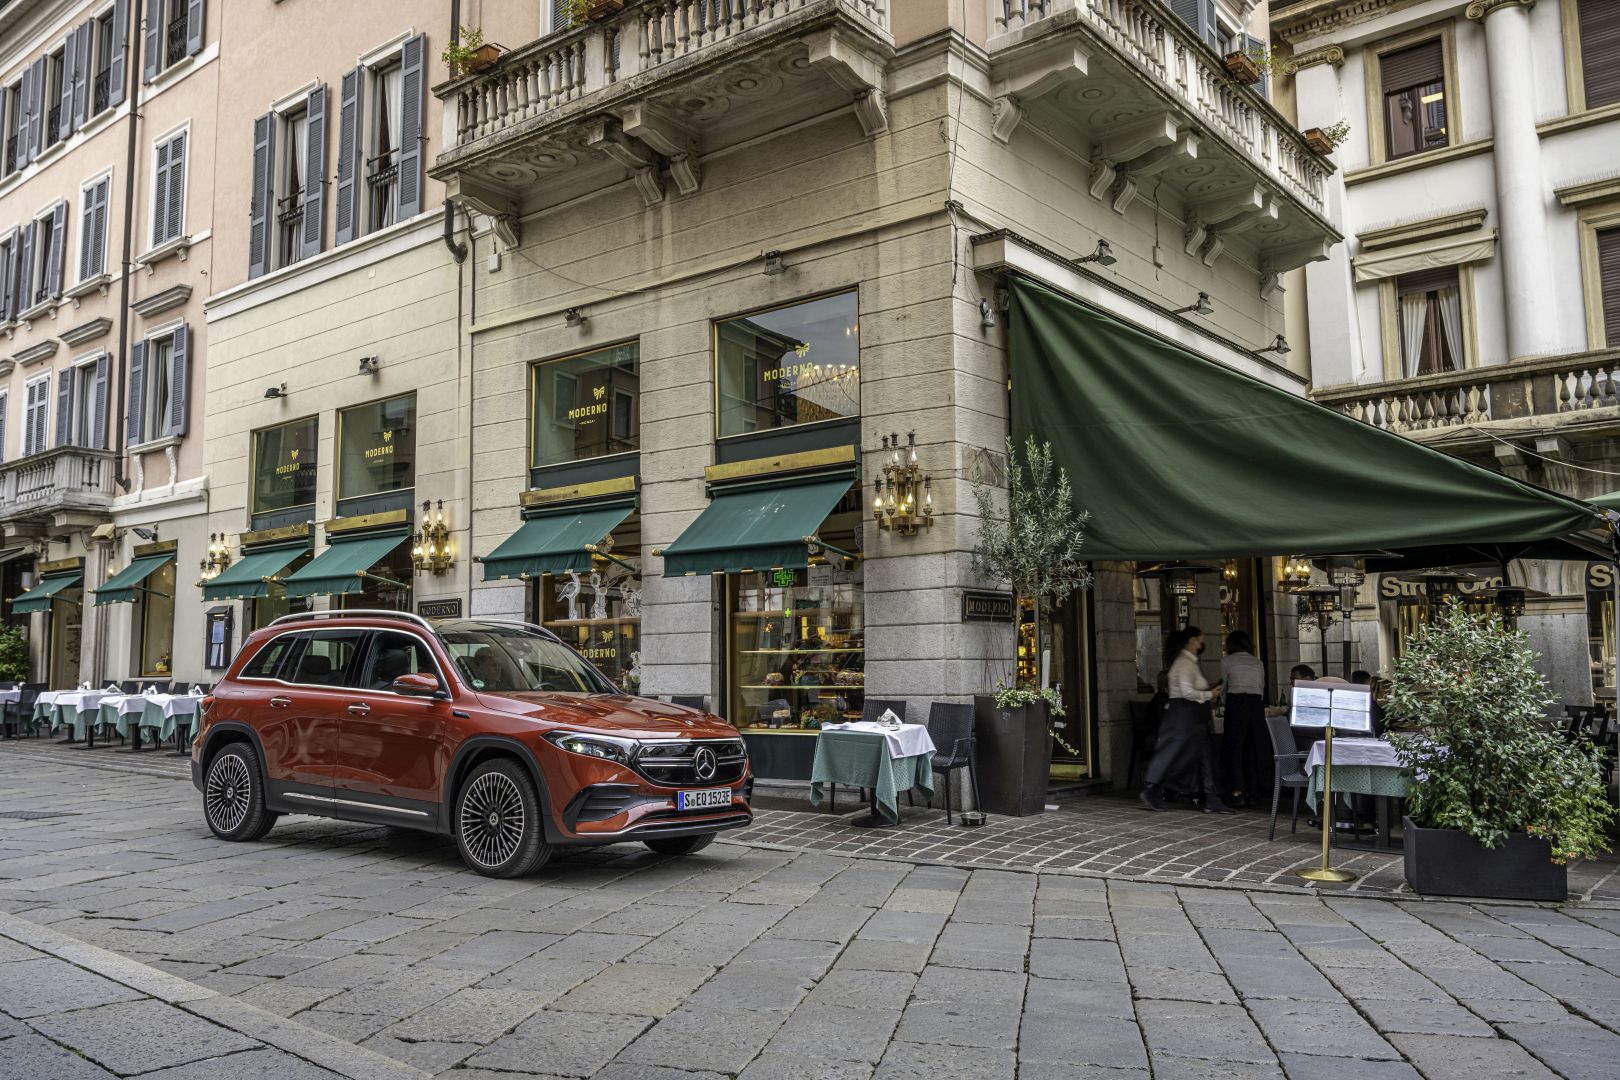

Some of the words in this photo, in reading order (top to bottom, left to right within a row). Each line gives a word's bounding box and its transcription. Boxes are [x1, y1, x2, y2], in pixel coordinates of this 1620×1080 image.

[764, 362, 813, 382] MODERNO
[568, 403, 607, 420] MODERNO
[365, 445, 394, 458] MODERNO
[275, 462, 300, 475] MODERNO
[421, 605, 456, 616] MODERNO
[968, 599, 1009, 613] MODERNO
[685, 793, 690, 807] S
